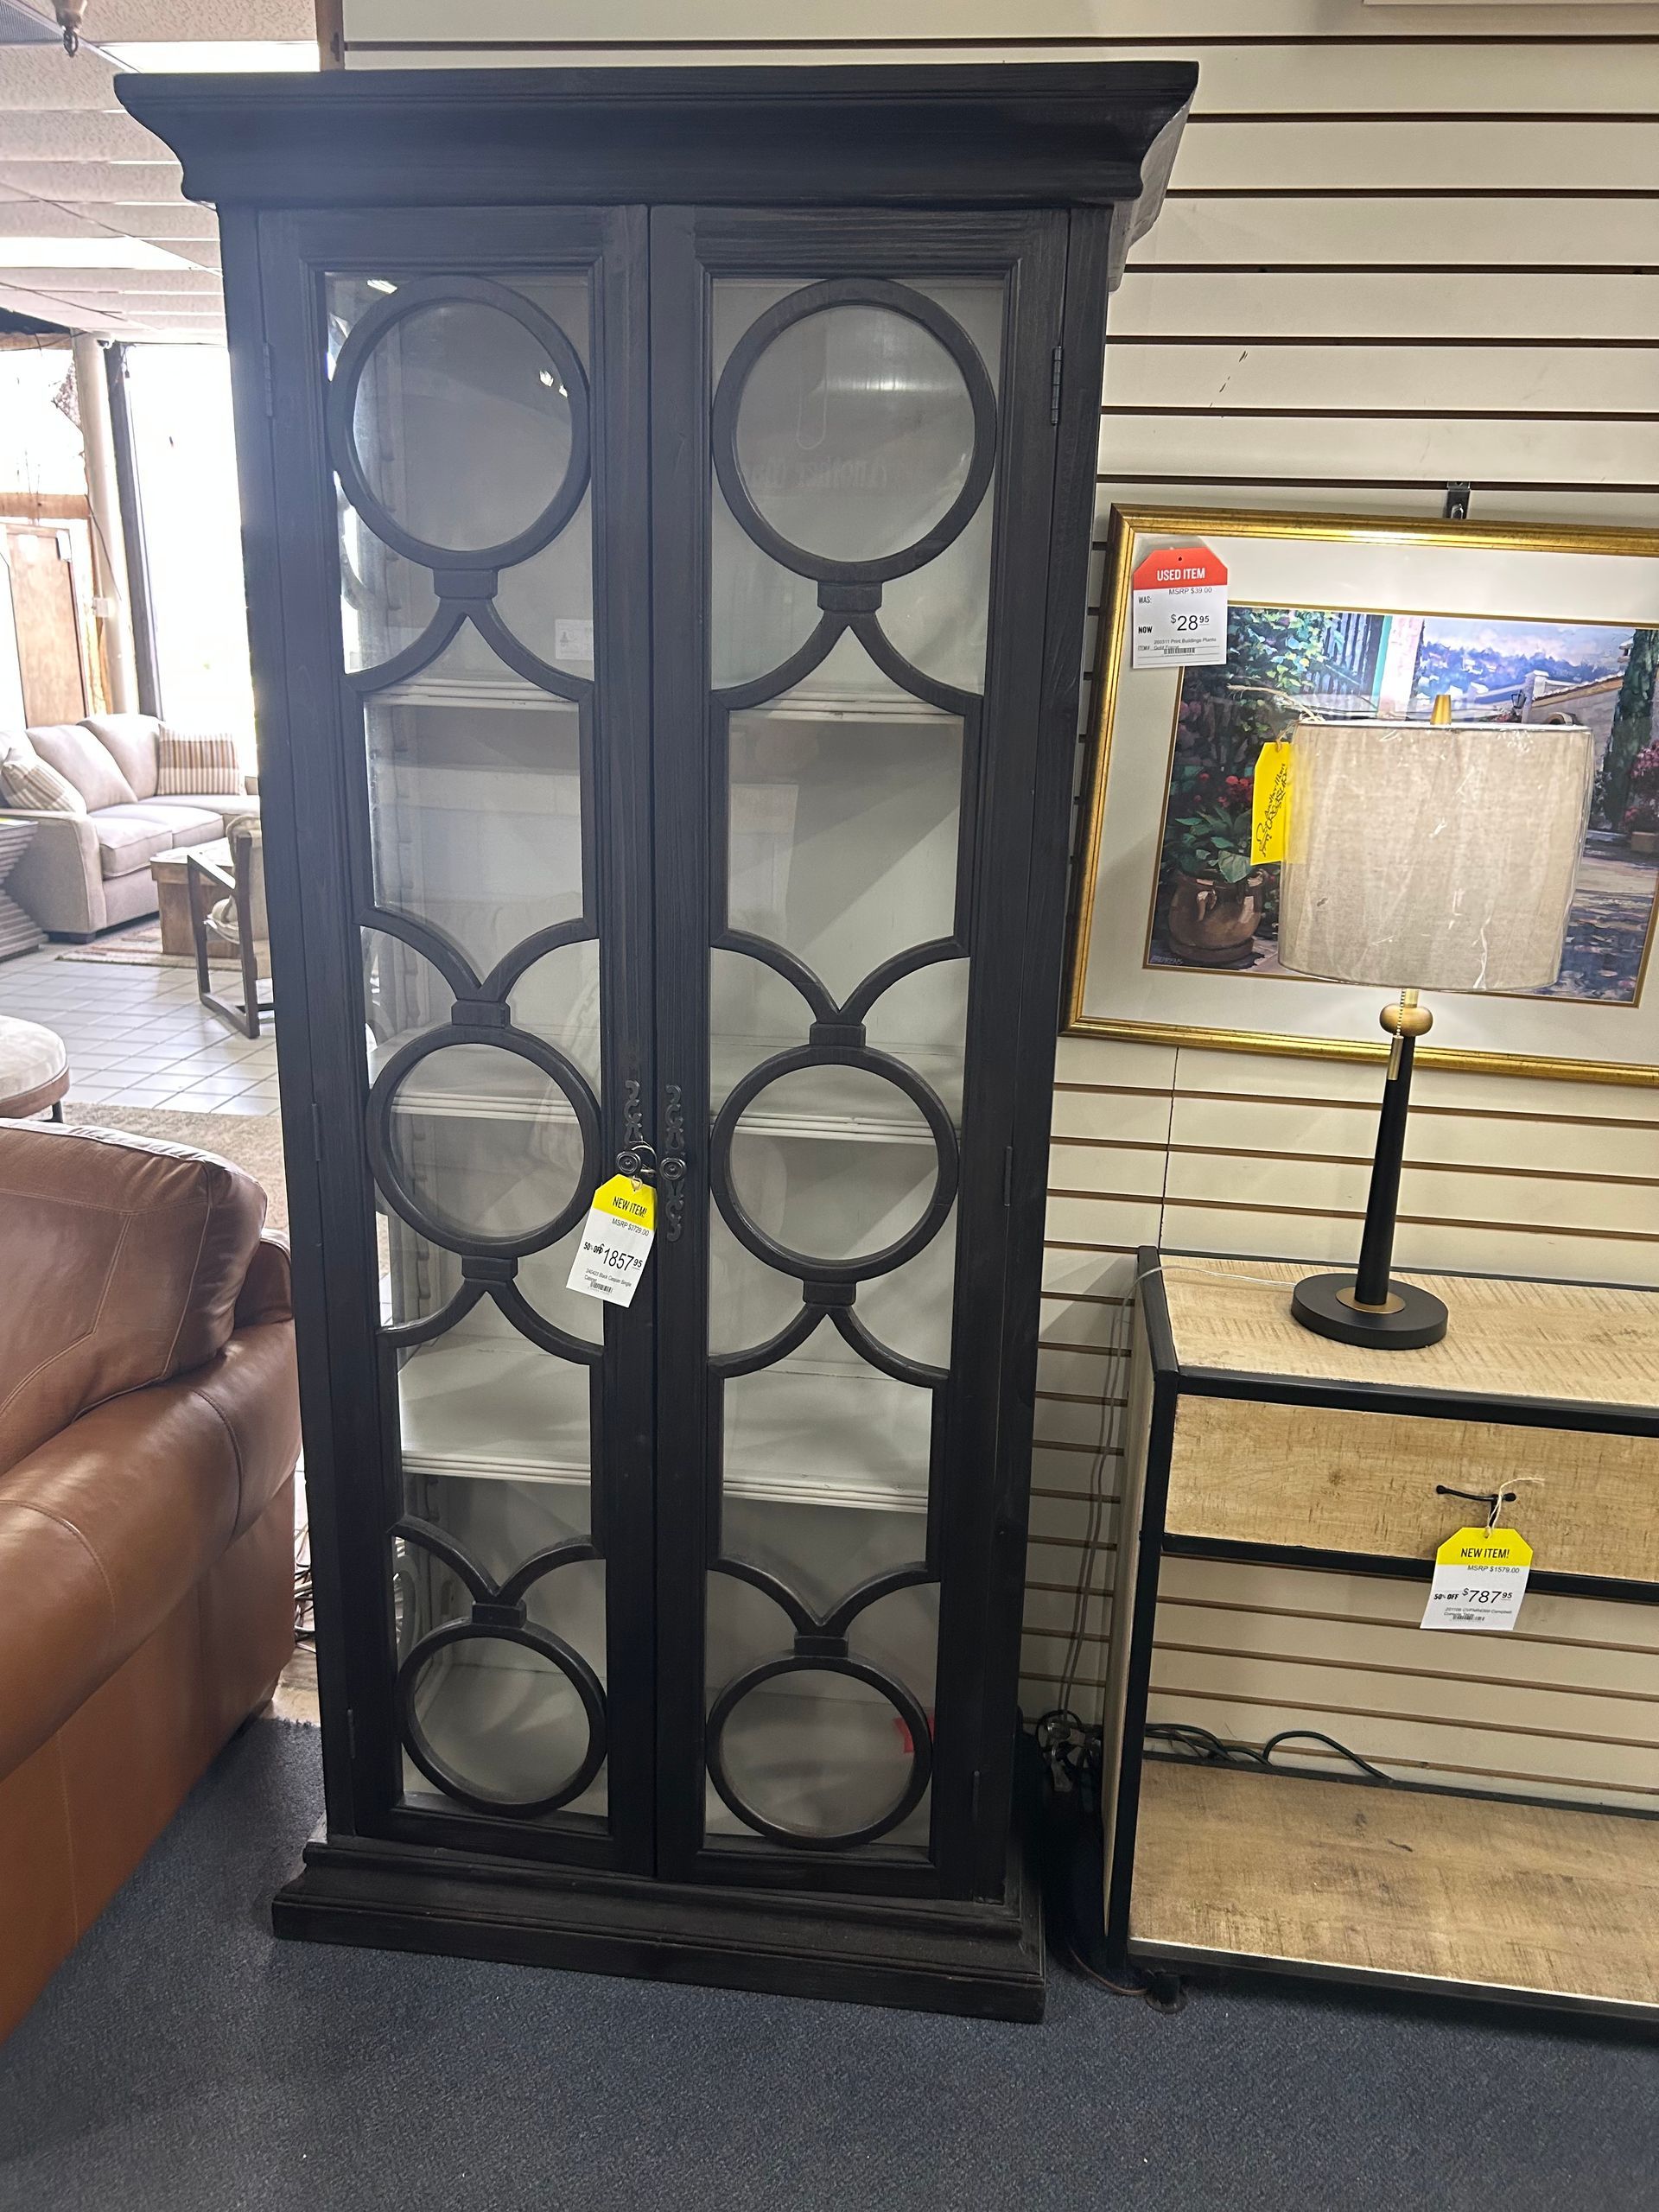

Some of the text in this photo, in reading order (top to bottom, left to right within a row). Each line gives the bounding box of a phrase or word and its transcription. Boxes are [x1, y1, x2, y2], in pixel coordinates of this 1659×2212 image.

[1156, 567, 1205, 582] USED ITEM
[1138, 626, 1153, 634] NOW
[612, 1196, 647, 1218] NEW ITEM!
[612, 1217, 628, 1229] MSRP
[1460, 1548, 1510, 1559] NEW ITEM!
